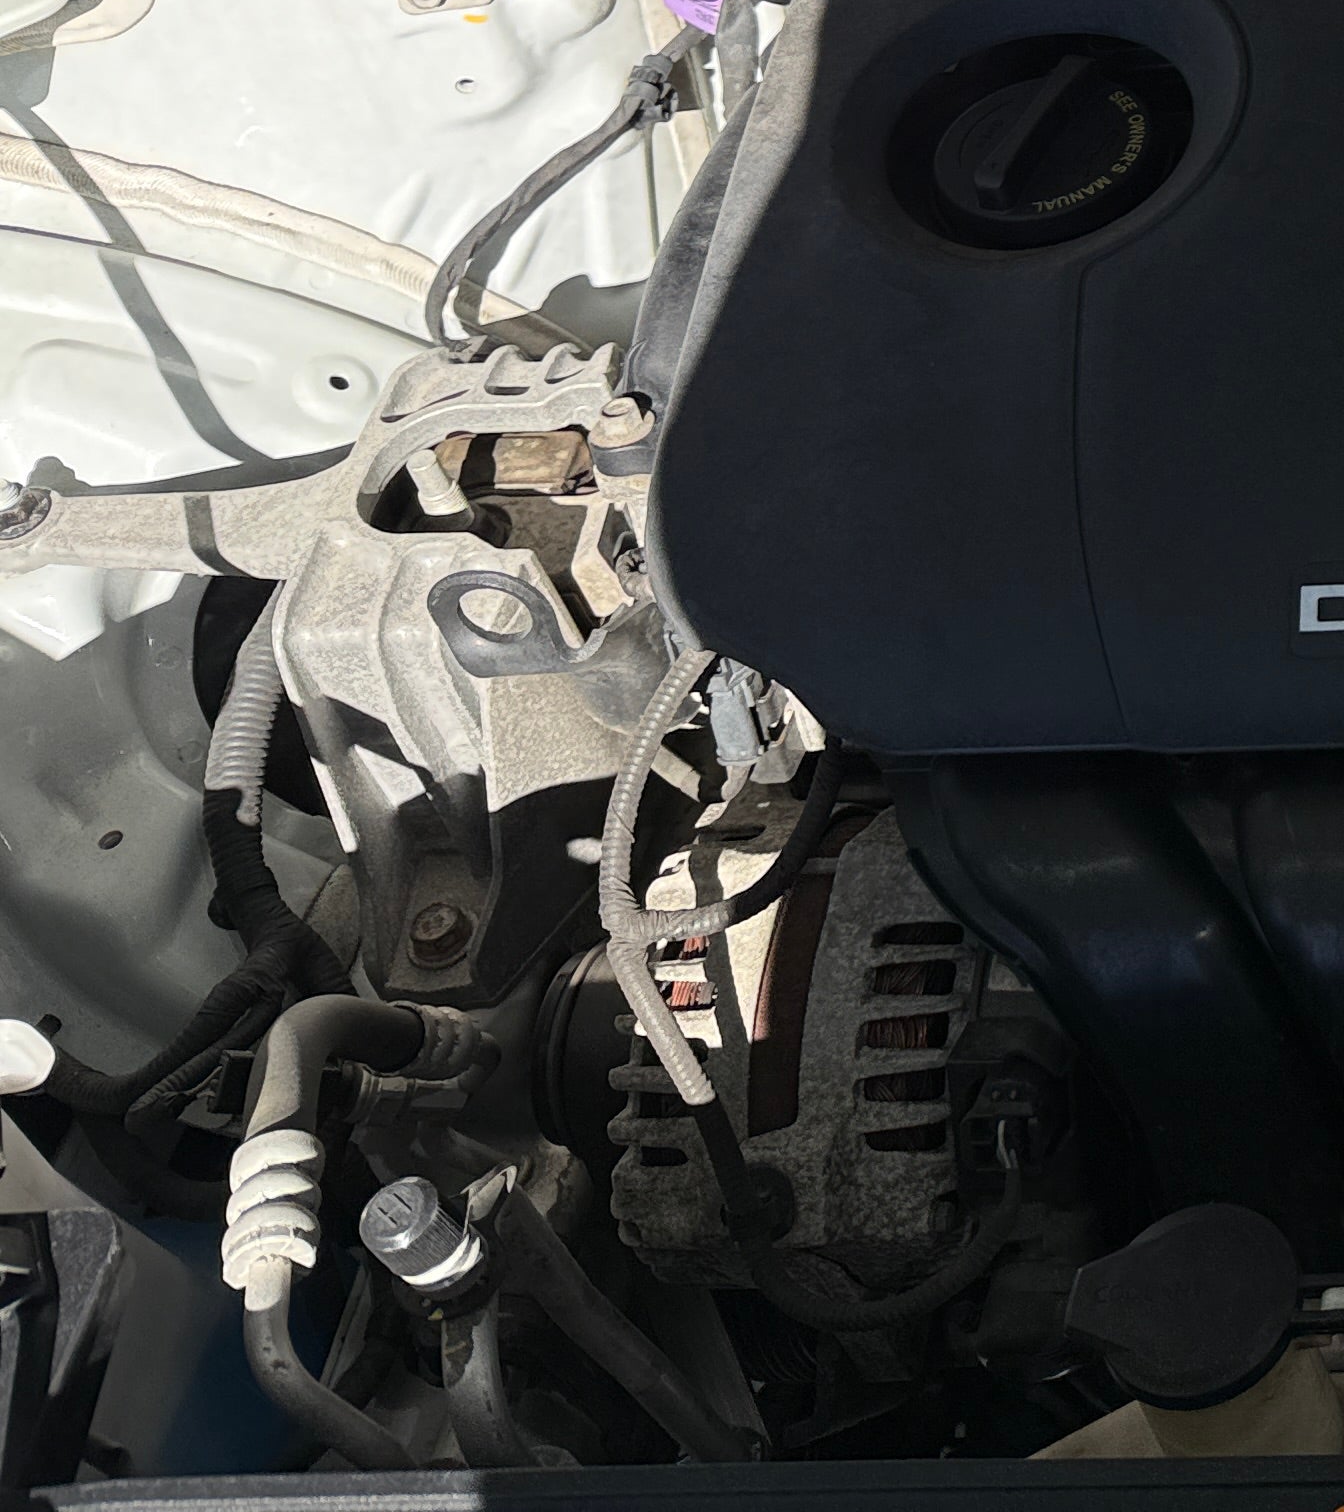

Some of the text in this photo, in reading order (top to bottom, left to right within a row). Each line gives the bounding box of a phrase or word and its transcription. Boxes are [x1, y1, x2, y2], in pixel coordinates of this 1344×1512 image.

[1032, 90, 1147, 213] SEE OWNER'S MANUAL
